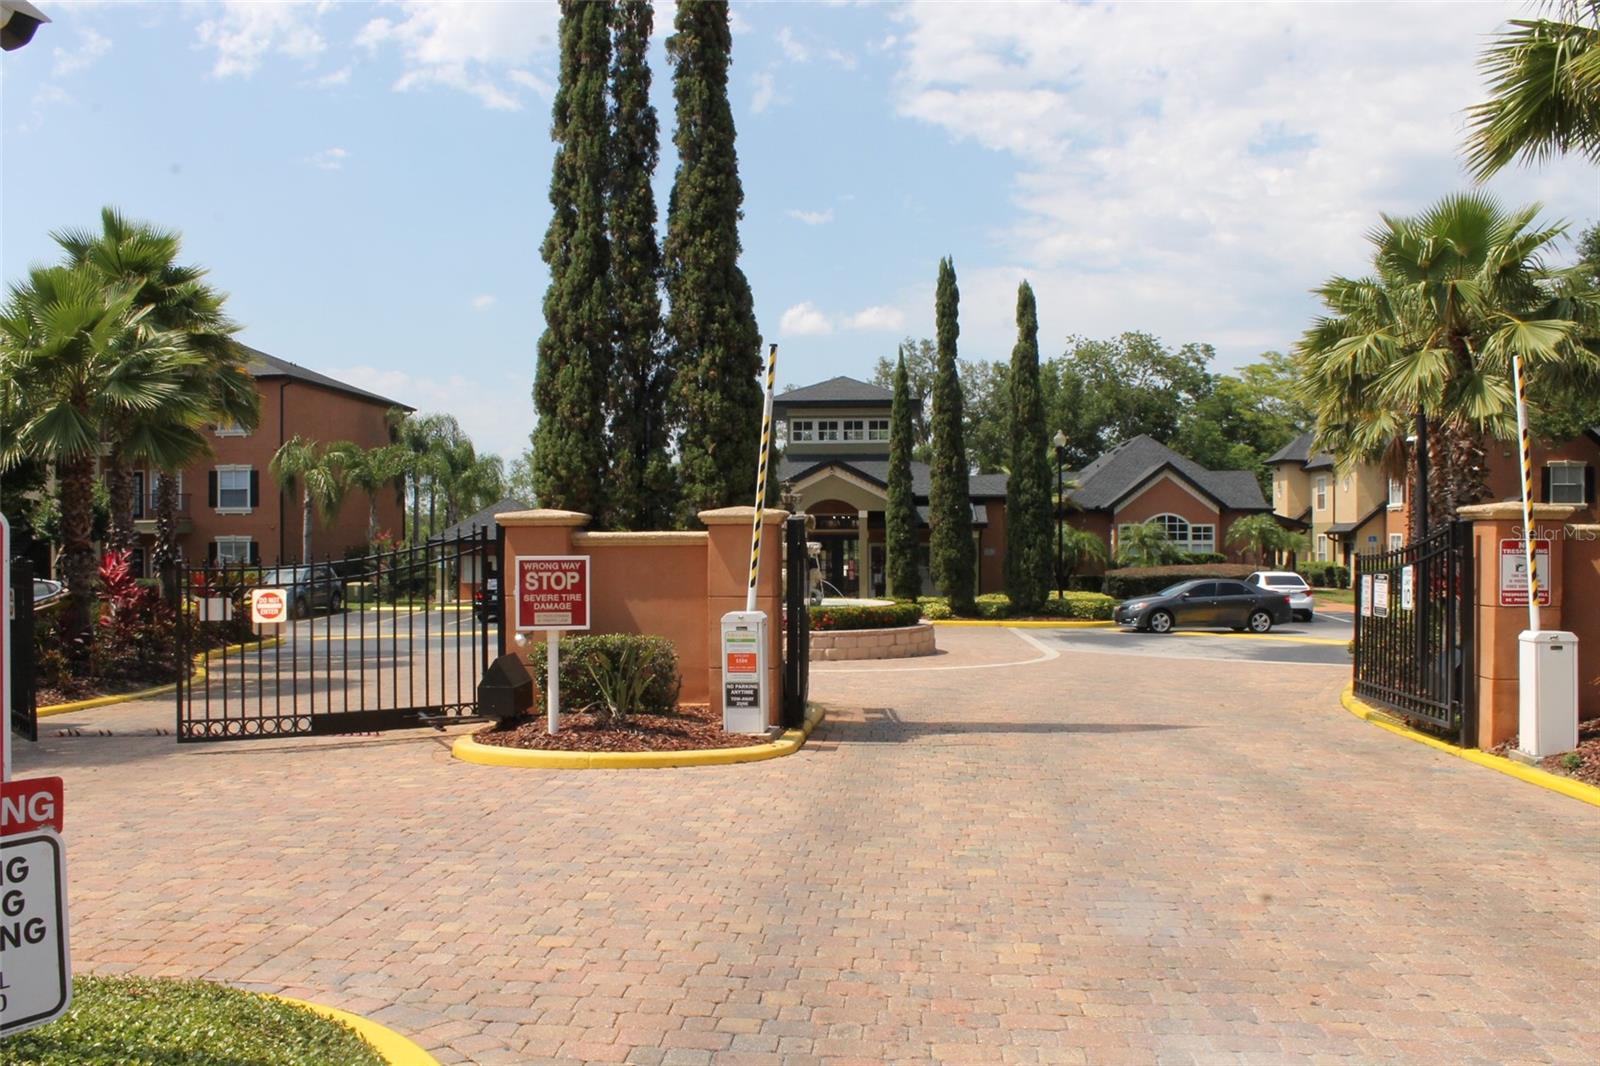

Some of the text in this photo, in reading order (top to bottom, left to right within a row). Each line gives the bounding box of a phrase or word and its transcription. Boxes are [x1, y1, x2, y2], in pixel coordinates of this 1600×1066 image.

[523, 562, 581, 570] WRONG WAY
[525, 571, 580, 591] STOP
[523, 593, 582, 602] SEVERE TIRE
[1, 791, 55, 826] NG
